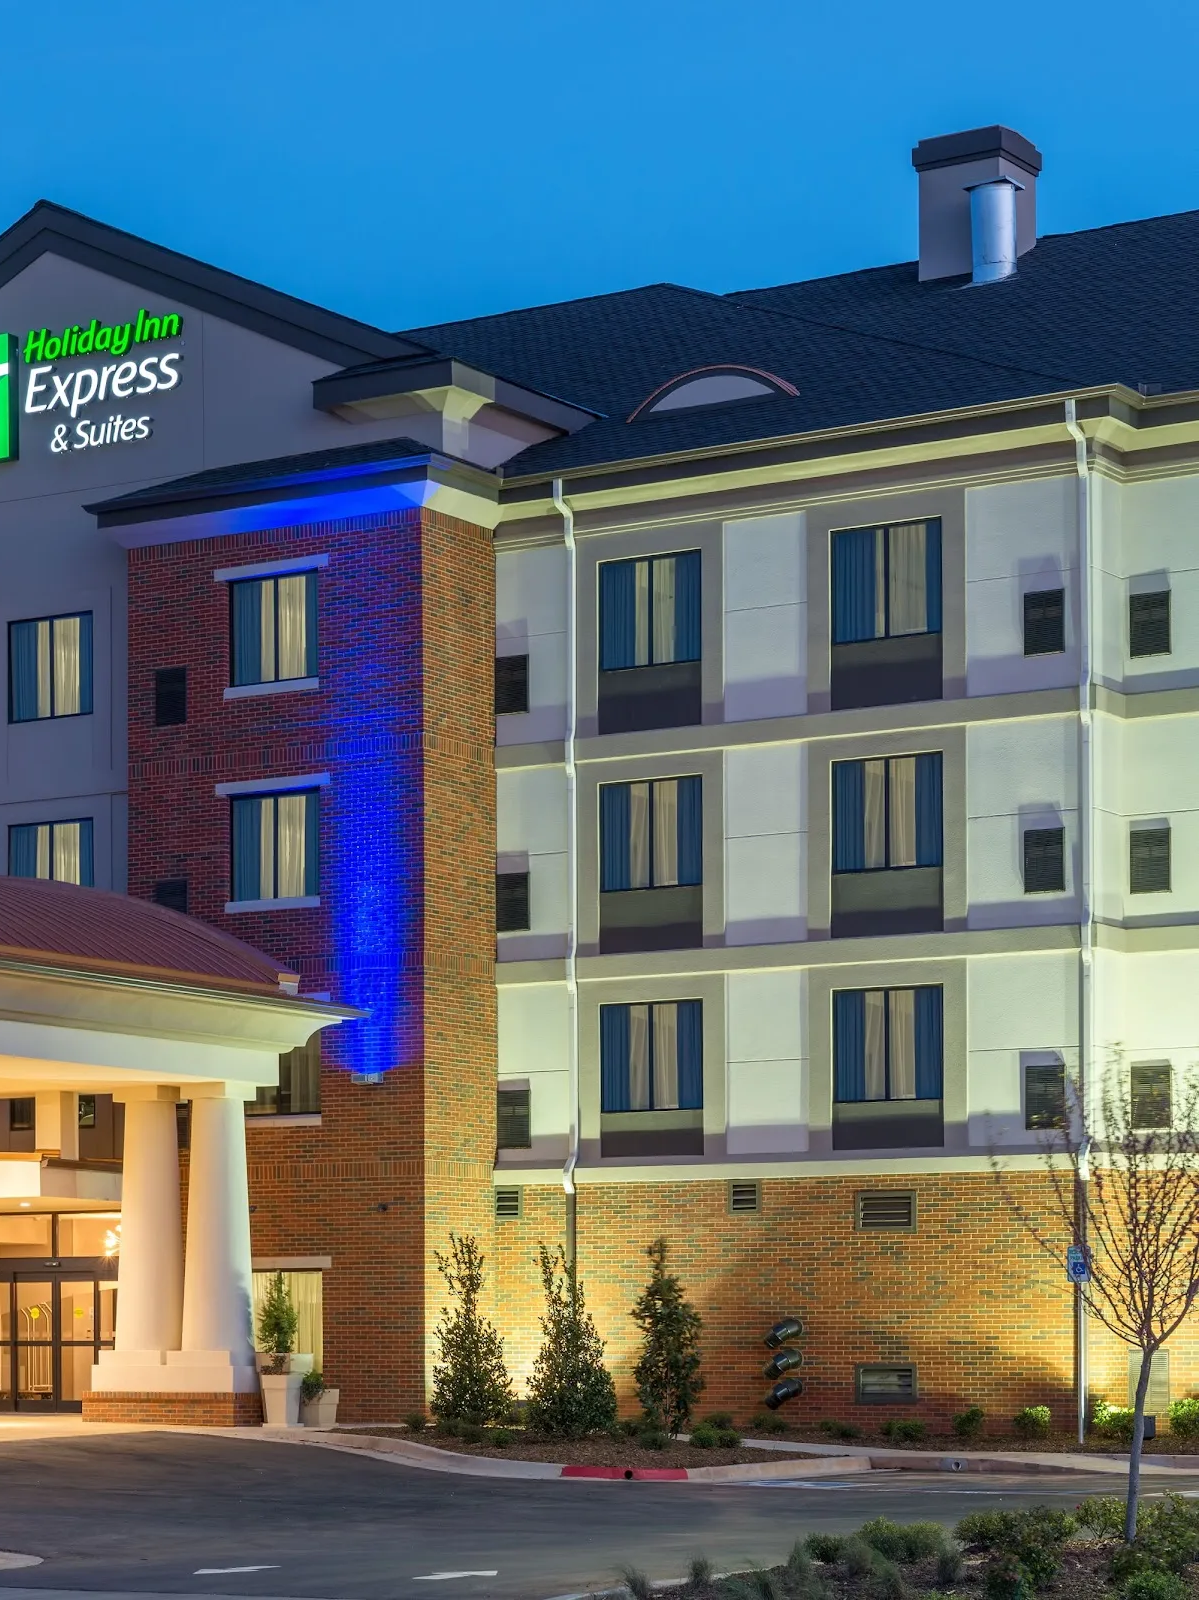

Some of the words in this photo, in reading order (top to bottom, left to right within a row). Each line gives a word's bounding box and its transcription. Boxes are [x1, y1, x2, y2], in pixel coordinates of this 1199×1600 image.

[23, 319, 133, 364] Holiday
[135, 308, 182, 344] Inn
[24, 352, 181, 419] Express
[50, 423, 69, 454] &
[73, 414, 151, 451] Suites
